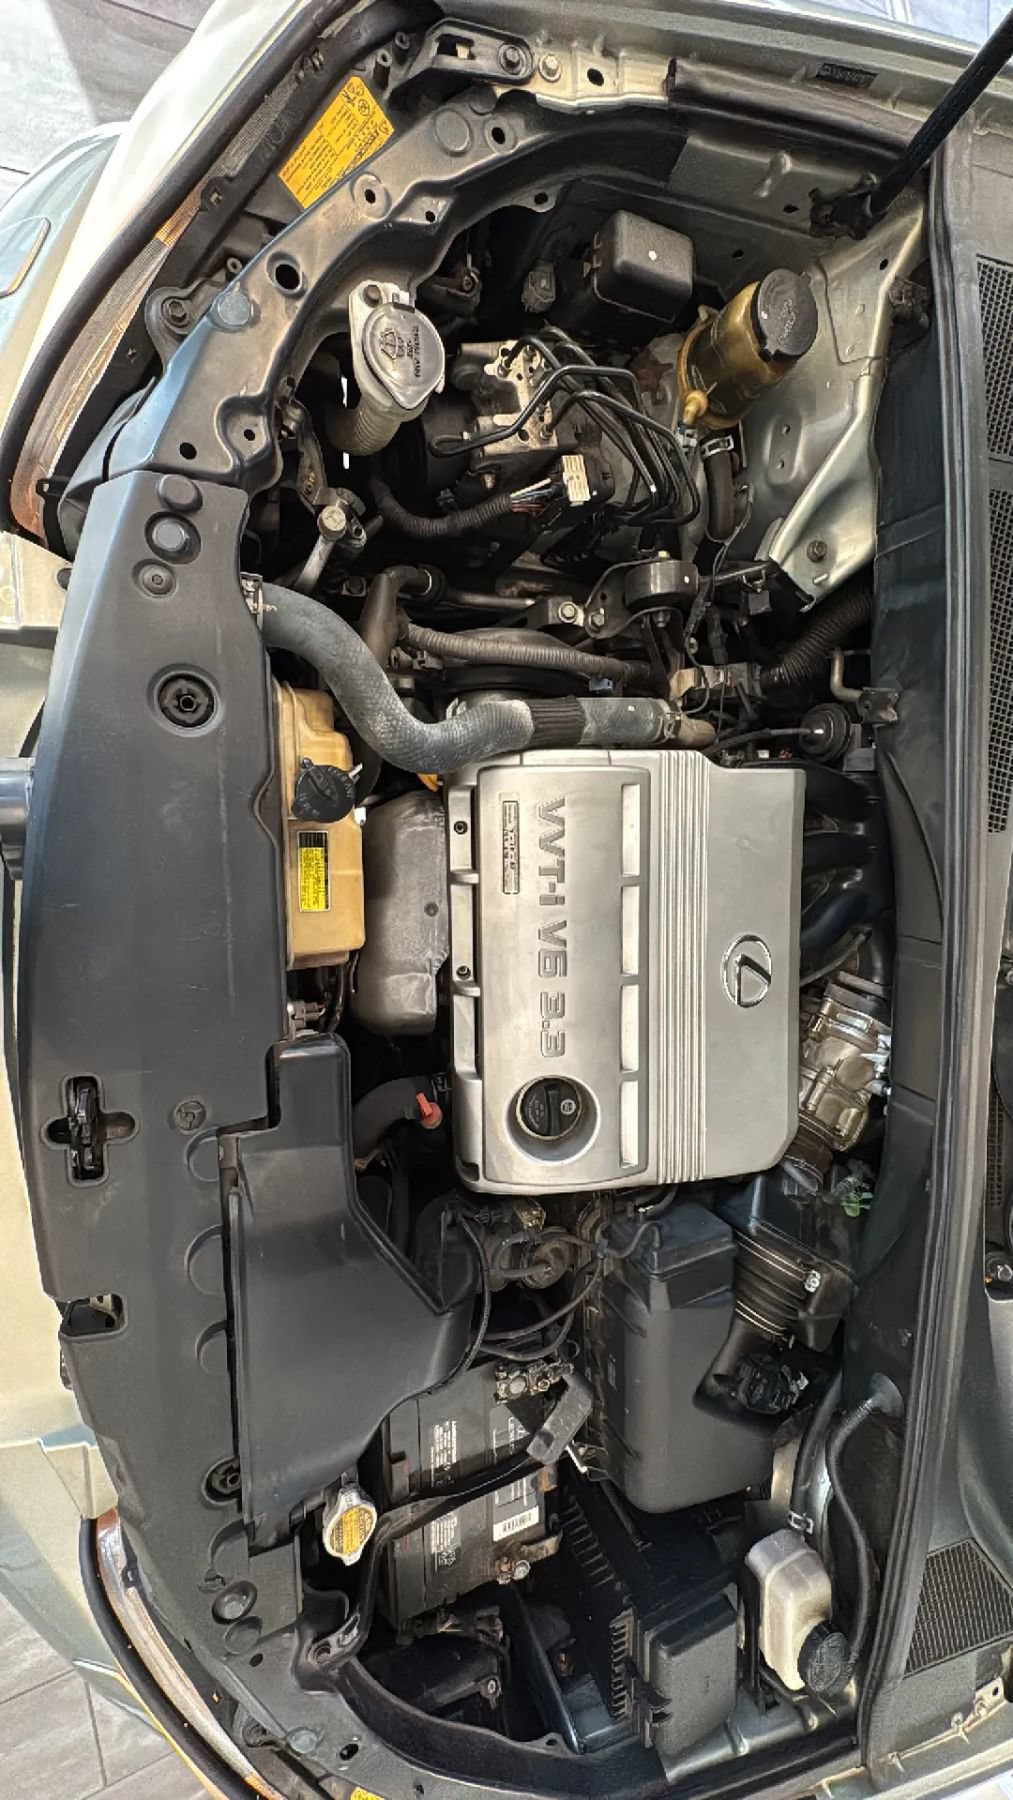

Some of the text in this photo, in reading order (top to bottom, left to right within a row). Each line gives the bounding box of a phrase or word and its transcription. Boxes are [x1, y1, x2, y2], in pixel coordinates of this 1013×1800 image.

[538, 796, 567, 1058] VVT-i V6 3.3
